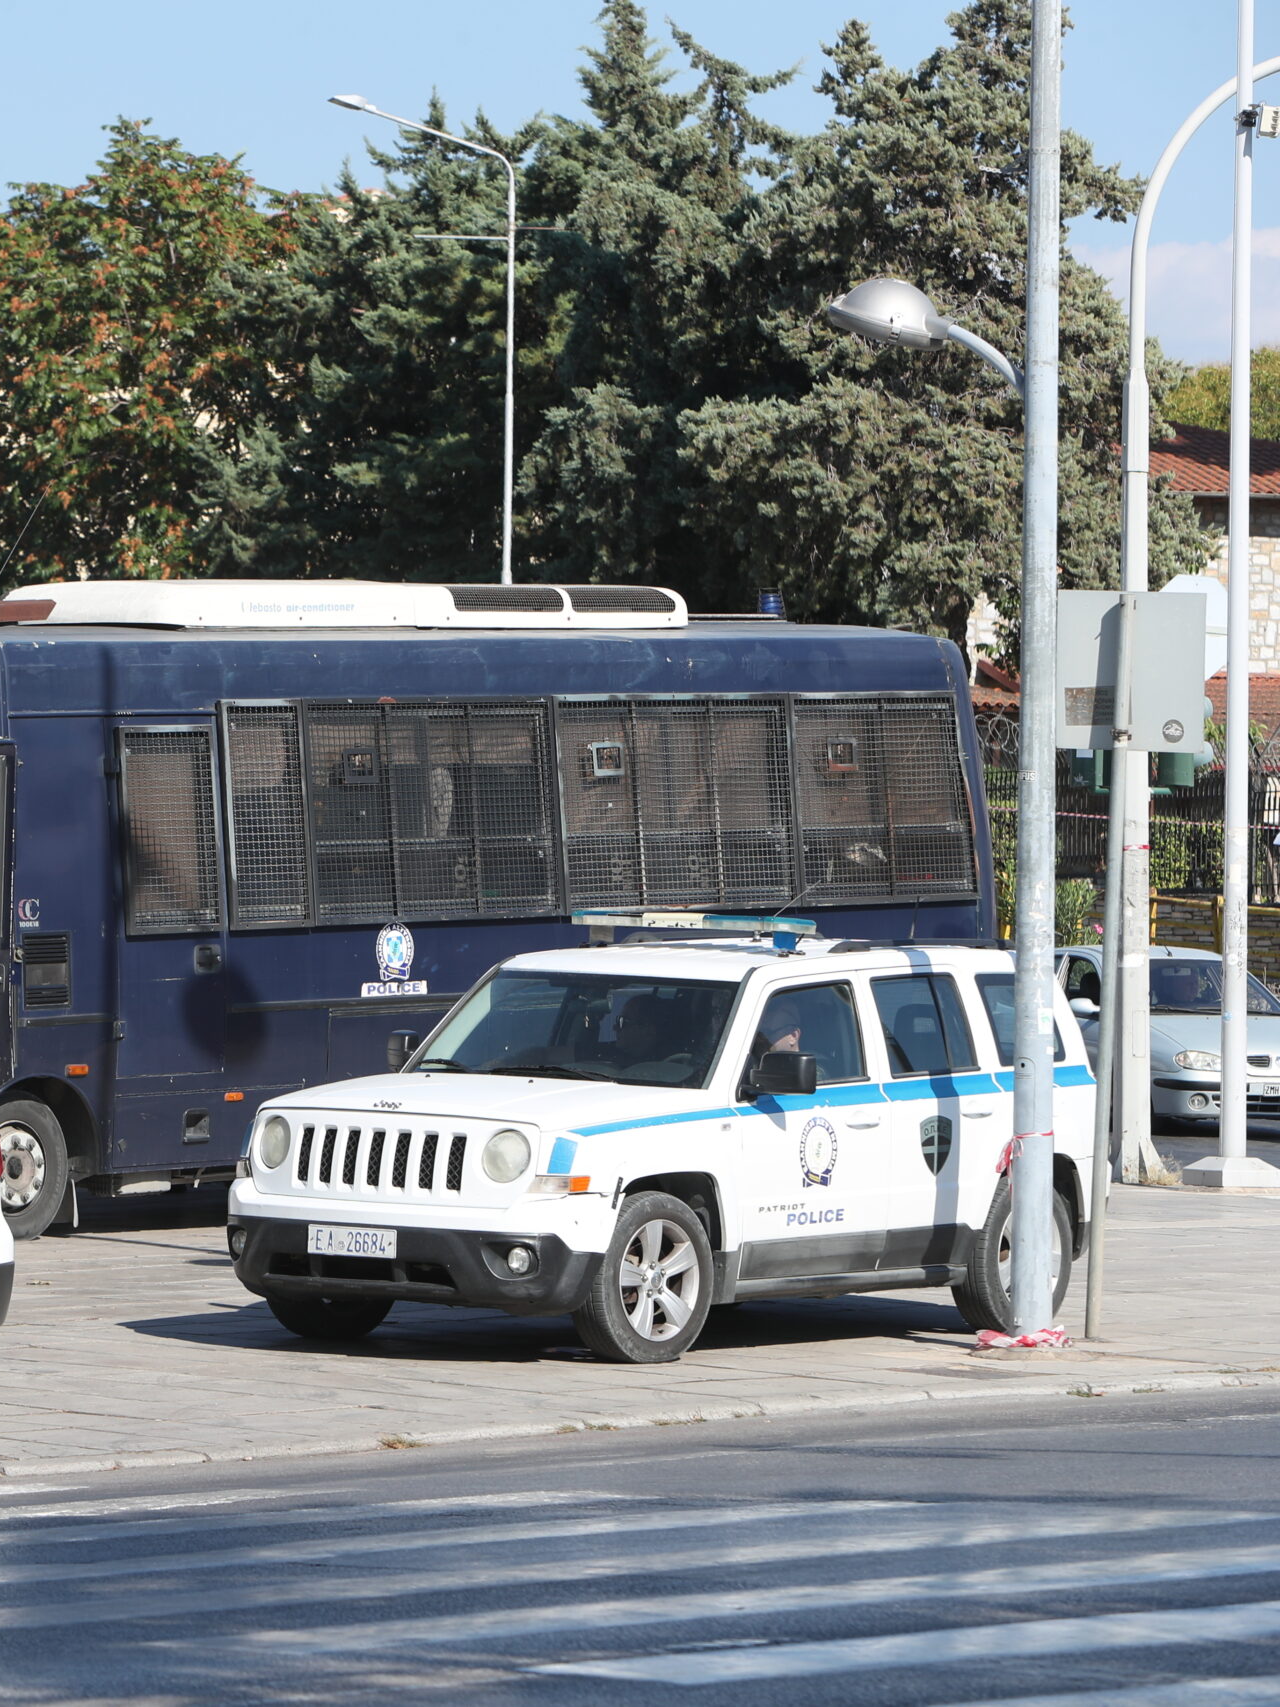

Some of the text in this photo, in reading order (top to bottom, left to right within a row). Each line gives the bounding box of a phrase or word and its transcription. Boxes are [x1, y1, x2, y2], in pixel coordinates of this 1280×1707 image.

[286, 602, 355, 613] air-conditioner
[367, 982, 421, 995] POLICE
[758, 1202, 806, 1213] PATRIOT
[786, 1208, 845, 1227] POLICE
[347, 1231, 385, 1254] 26684
